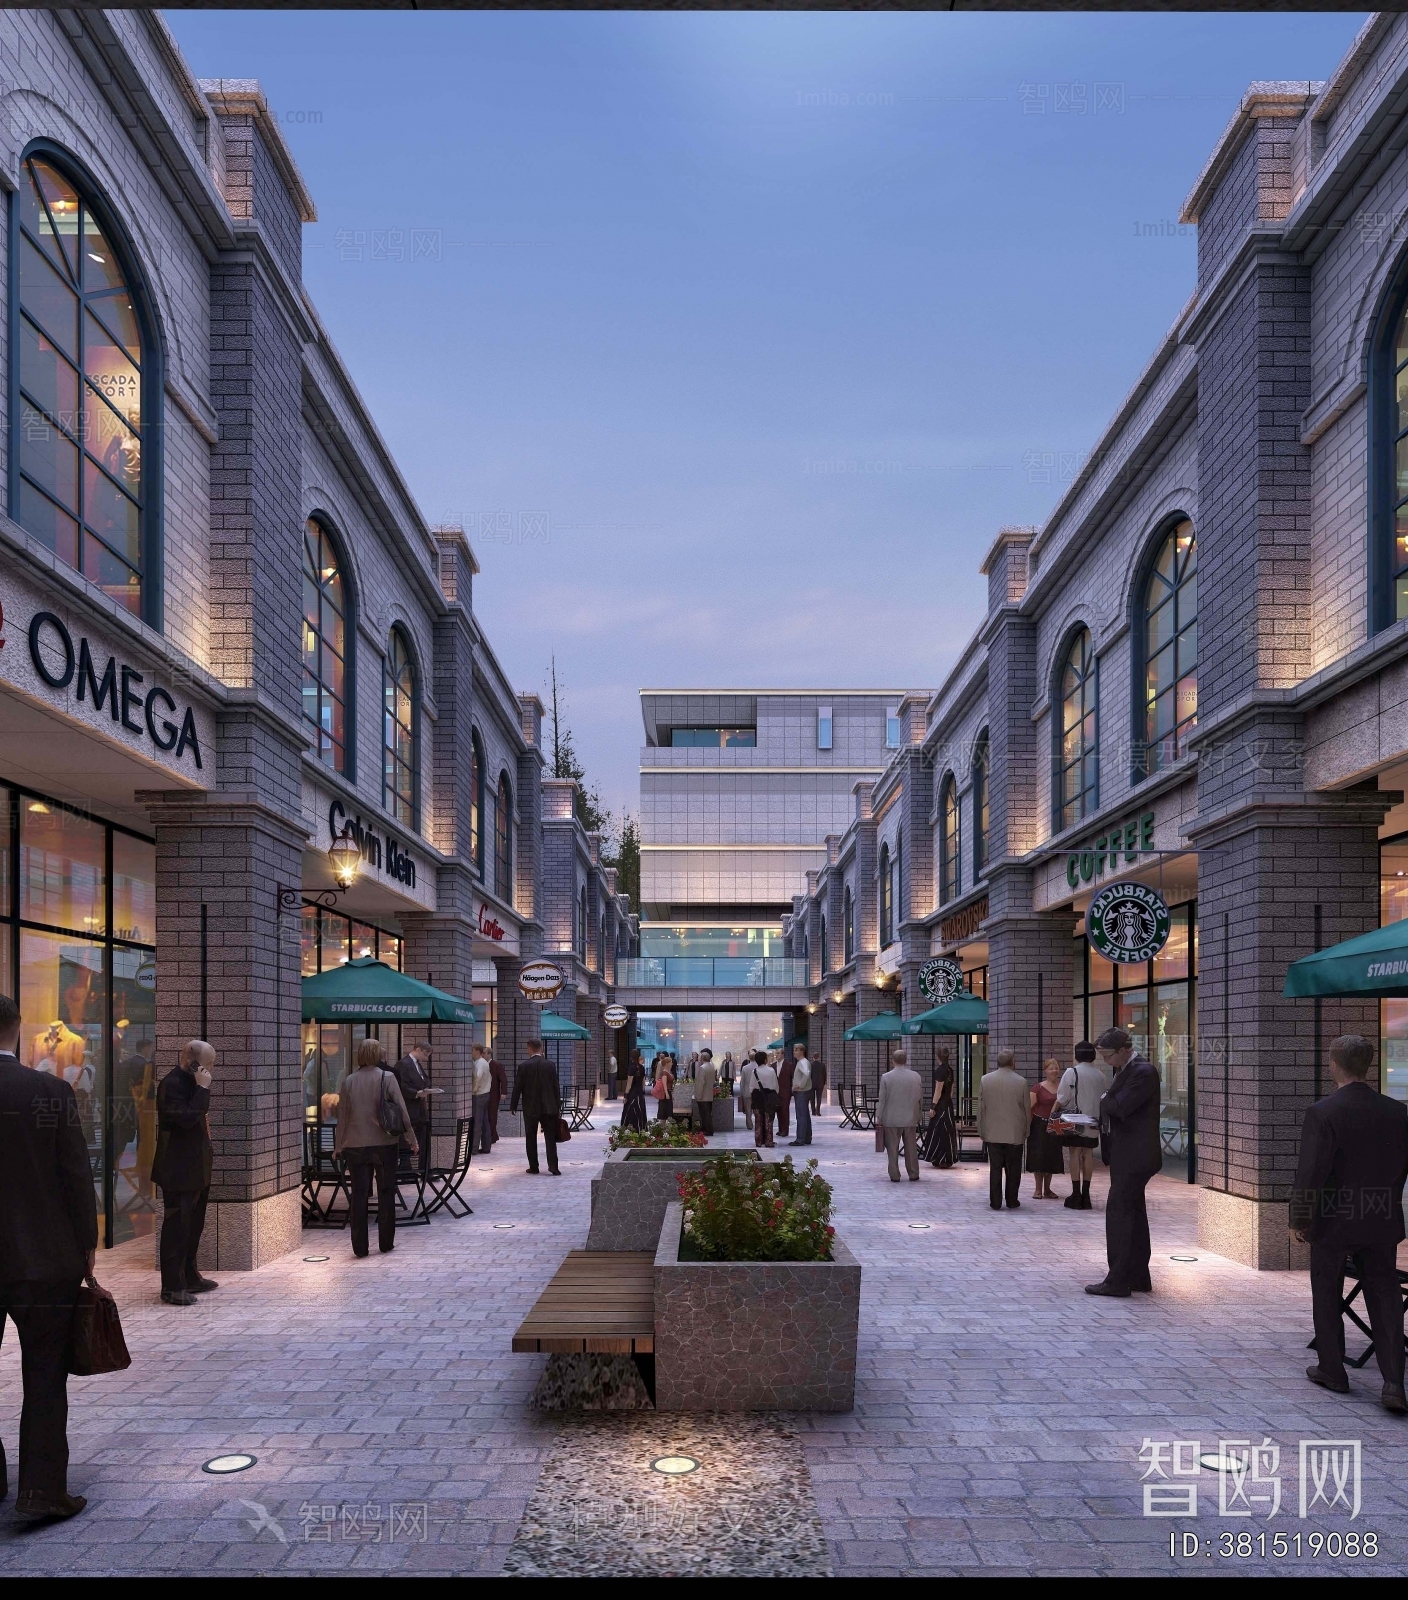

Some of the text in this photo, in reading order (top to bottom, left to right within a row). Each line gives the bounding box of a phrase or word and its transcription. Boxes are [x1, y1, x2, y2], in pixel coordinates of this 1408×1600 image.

[85, 386, 136, 397] SORT
[88, 375, 136, 385] SCADA
[28, 611, 203, 769] OMEGA
[329, 800, 416, 889] Calvin Klein
[1066, 811, 1155, 887] COFFEE
[478, 903, 505, 941] Cartier
[331, 1003, 419, 1014] STARBUCKS COFFEE
